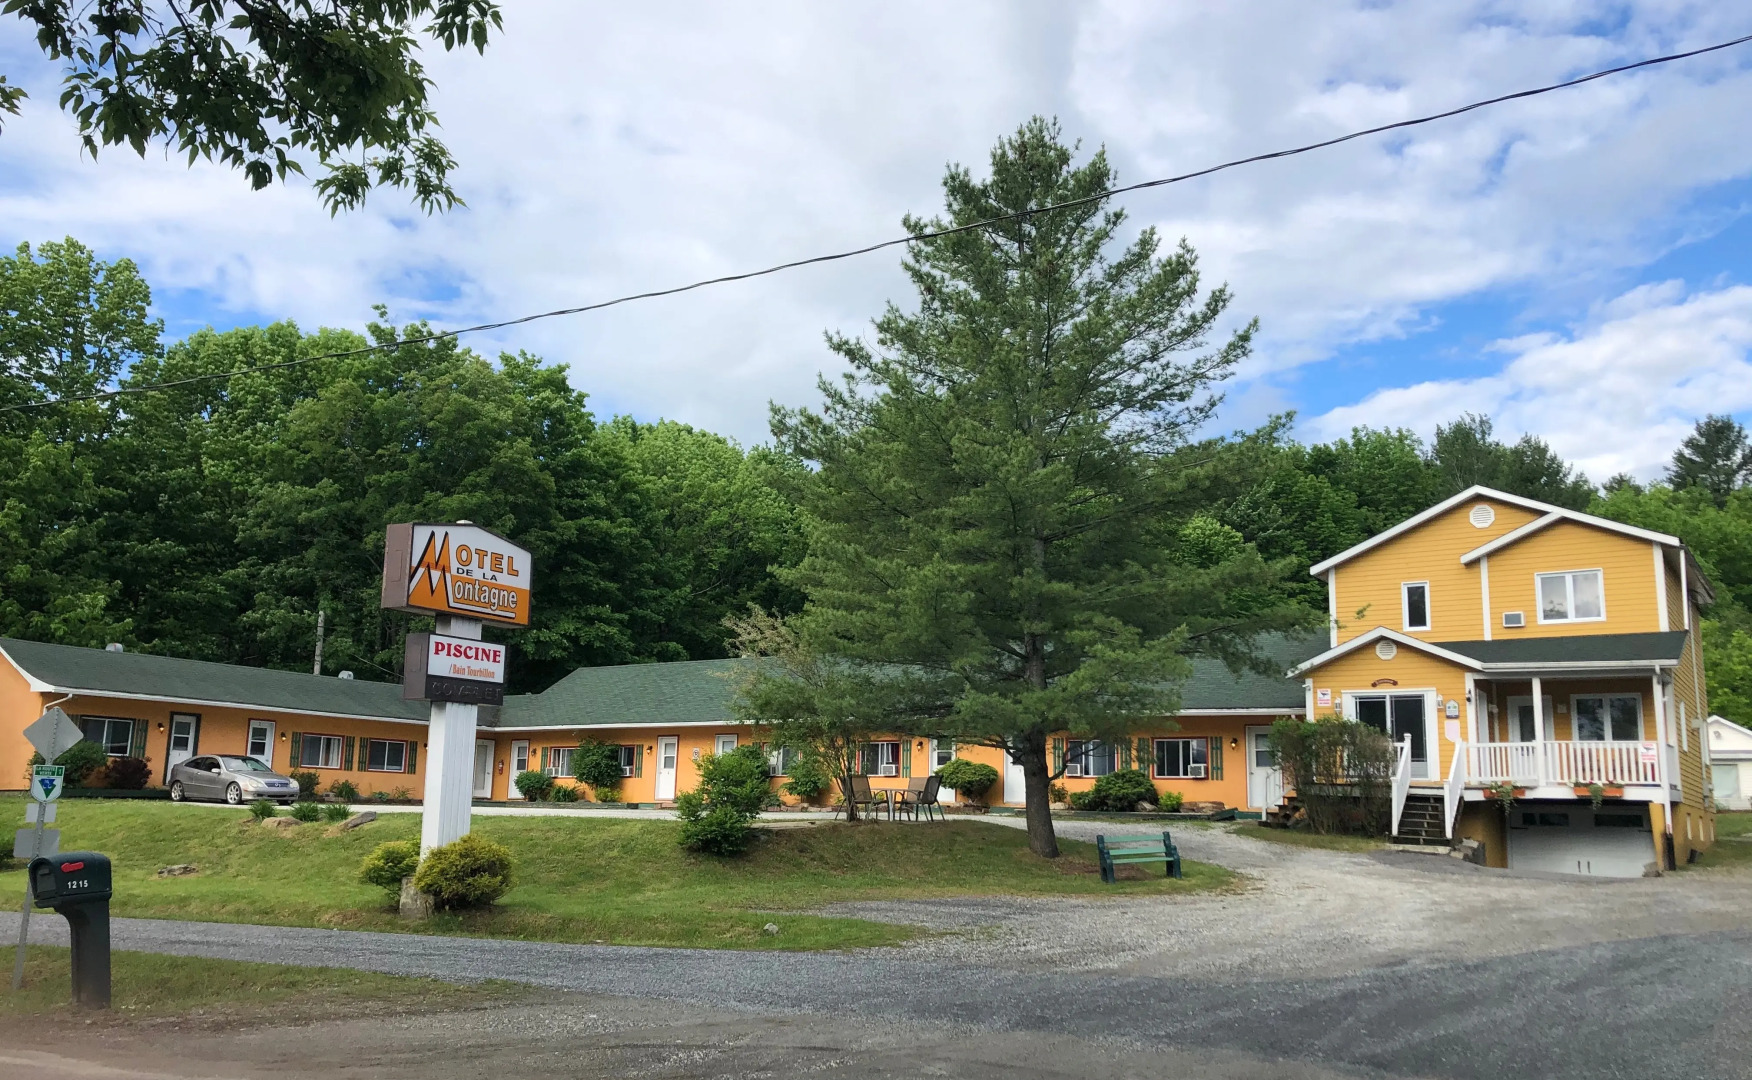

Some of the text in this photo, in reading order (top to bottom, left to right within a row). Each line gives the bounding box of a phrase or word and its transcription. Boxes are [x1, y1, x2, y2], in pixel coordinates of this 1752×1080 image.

[409, 530, 519, 582] MOTEL
[456, 567, 498, 582] DE LA
[409, 562, 518, 611] Montagne
[433, 641, 502, 664] PISCINE
[467, 665, 495, 679] Tourbillon
[67, 879, 89, 889] 1215
